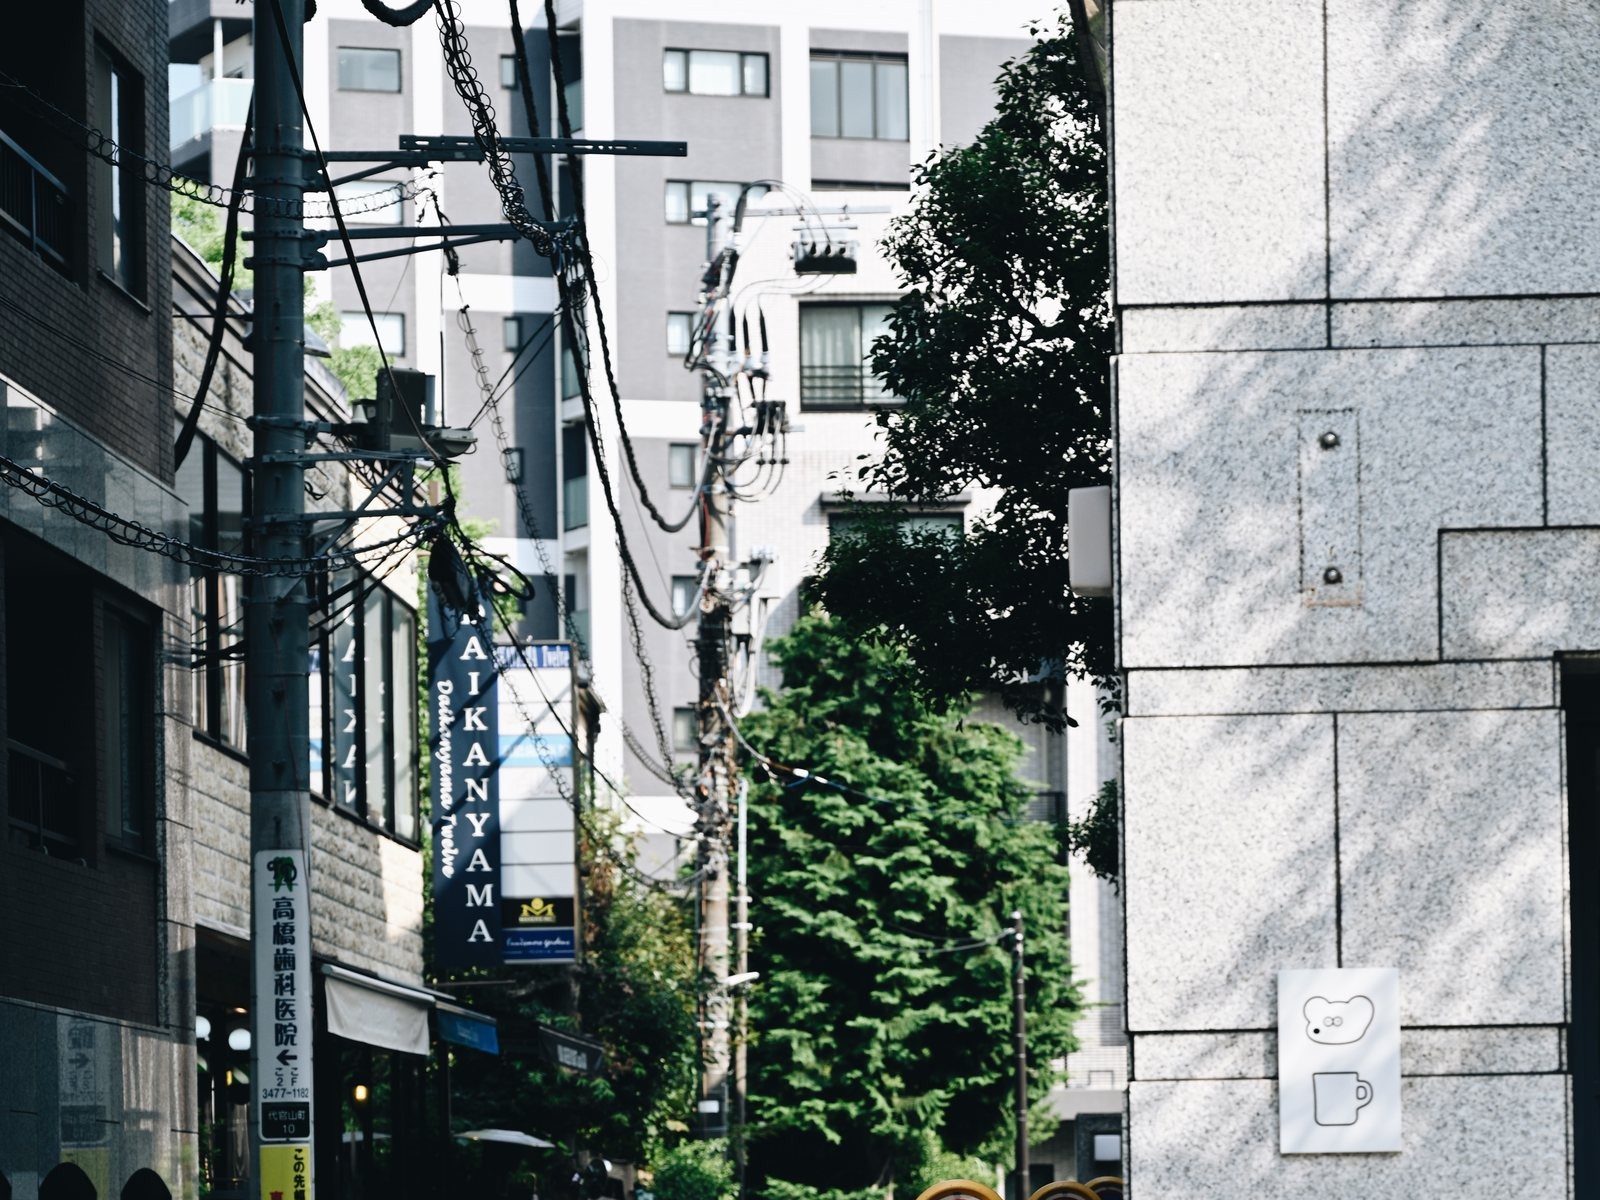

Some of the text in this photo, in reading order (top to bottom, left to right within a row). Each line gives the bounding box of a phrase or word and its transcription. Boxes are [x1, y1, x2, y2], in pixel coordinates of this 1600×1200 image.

[441, 814, 459, 879] Twelve
[272, 897, 298, 1047] 高橋歯科医院
[262, 1088, 309, 1099] 3477-1182
[268, 1110, 306, 1121] 代官山町
[282, 1124, 296, 1134] 10
